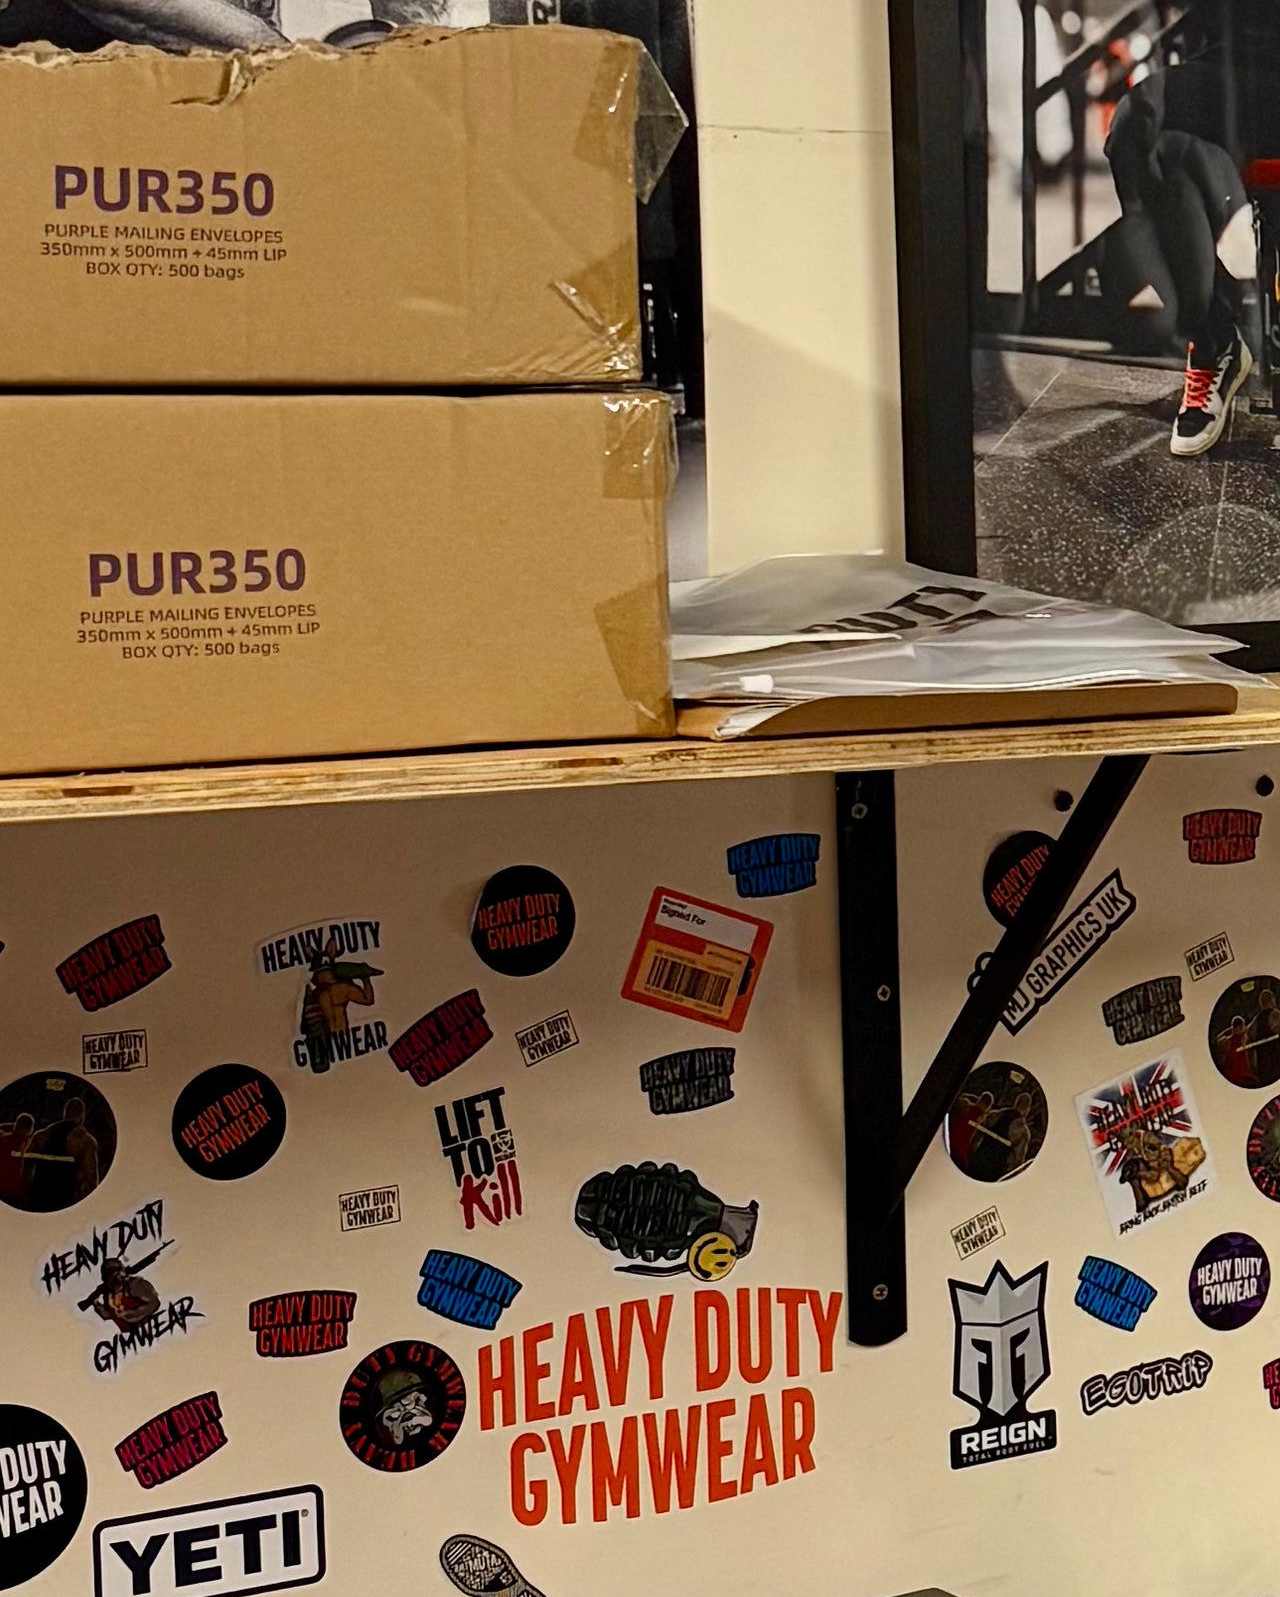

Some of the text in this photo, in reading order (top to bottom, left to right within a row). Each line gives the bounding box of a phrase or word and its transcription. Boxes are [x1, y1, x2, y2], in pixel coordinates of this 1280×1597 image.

[55, 165, 274, 217] PUR350
[40, 242, 105, 257] 350mm
[110, 247, 119, 257] x
[125, 245, 188, 260] 500mm
[206, 247, 258, 261] 45mm
[263, 249, 287, 261] LIP
[44, 224, 283, 243] PURPLE MAILING ENVELOPES
[86, 262, 245, 281] BOX QTY: 500 bags
[89, 548, 306, 597] PUR350
[77, 628, 141, 643] 350mm
[146, 631, 156, 640] x
[161, 626, 222, 640] 500mm
[241, 623, 293, 637] 45mm
[297, 622, 320, 635] LIP
[80, 604, 316, 625] PURPLE MAILING ENVELOPES
[123, 641, 280, 659] BOX QTY: 500 bags
[477, 893, 560, 931] HEAVY DUTY
[488, 916, 558, 950] GYMWEAR
[262, 921, 380, 973] HEAVY DUTY
[1002, 887, 1126, 1022] MJ GRAPHICS UK
[181, 1080, 263, 1148] HEAVY DUTY
[198, 1103, 271, 1163] GYMWEAR
[434, 1087, 506, 1147] LIFT
[443, 1137, 494, 1186] TO
[460, 1159, 522, 1229] Kill
[41, 1199, 164, 1294] HEAVY DUTY
[954, 1221, 978, 1243] HEAVY
[424, 1253, 521, 1301] HEAVY DUTY
[1083, 1259, 1156, 1308] HEAVY DUTY
[1198, 1257, 1263, 1287] HEAVY DUTY
[1203, 1283, 1258, 1306] GYMWEAR
[253, 1294, 352, 1328] HEAVY DUTY
[420, 1278, 502, 1328] GYMWEAR
[1077, 1284, 1141, 1328] GYMWEAR
[259, 1322, 345, 1354] GYMWEAR
[478, 1288, 842, 1431] HEAVY DUTY
[120, 1392, 220, 1470] HEAVY DUTY
[135, 1422, 225, 1487] GYMWEAR
[961, 1417, 1048, 1455] REIGN
[962, 1449, 992, 1464] TOTAL
[1023, 1440, 1046, 1453] FUEL
[511, 1387, 816, 1526] GYMWEAR
[109, 1510, 301, 1595] YETI
